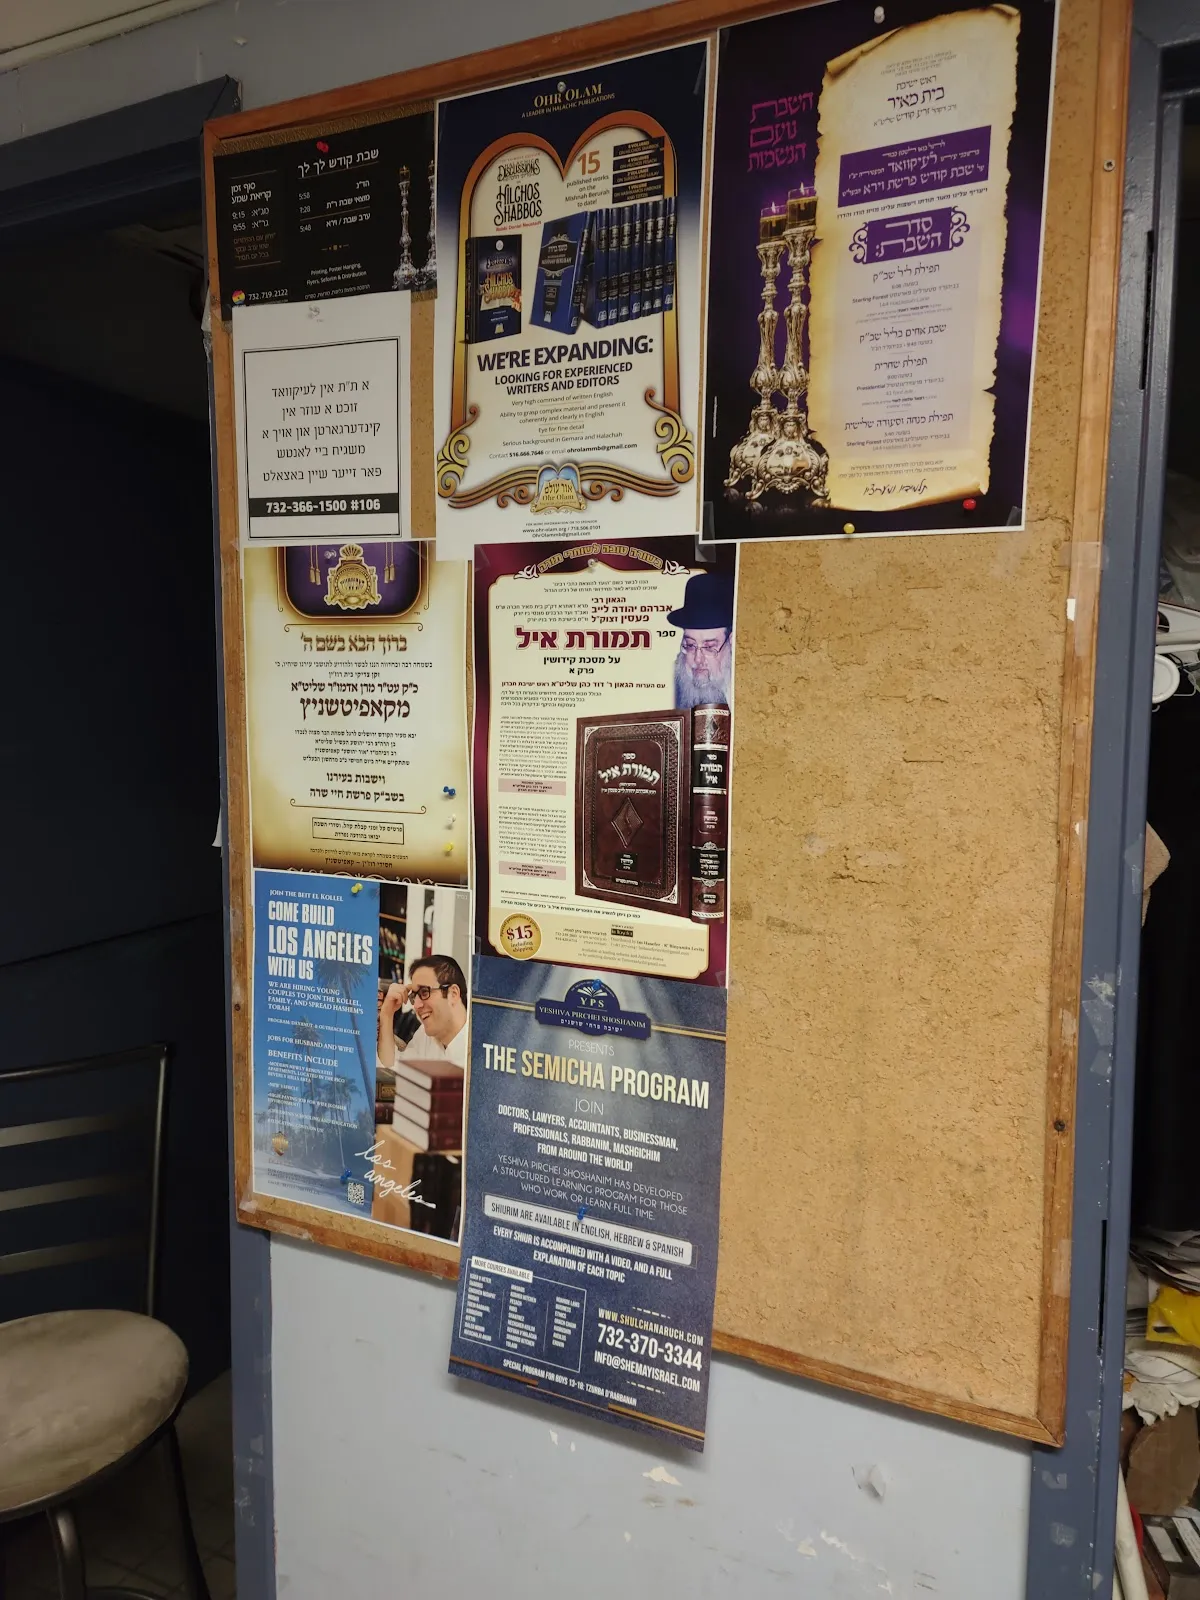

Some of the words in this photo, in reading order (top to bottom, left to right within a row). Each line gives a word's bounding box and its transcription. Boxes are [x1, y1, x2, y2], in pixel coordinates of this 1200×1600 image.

[534, 92, 563, 107] OHR
[566, 83, 601, 101] OLAM
[328, 154, 352, 168] קודש
[356, 148, 378, 162] שבת
[297, 162, 310, 177] לך
[313, 158, 325, 174] לך
[576, 150, 600, 175] 15
[231, 194, 248, 204] שמע
[249, 190, 271, 201] קריאת
[298, 191, 310, 200] 5:58
[495, 182, 541, 205] HILCHOS
[231, 210, 245, 219] 9:15
[493, 199, 542, 226] SHABBOS
[232, 222, 246, 231] 9:55
[885, 216, 932, 232] סדר
[247, 288, 288, 300] 732.719.2122
[476, 348, 530, 371] WE'RE
[534, 336, 653, 365] EXPANDING:
[873, 360, 900, 371] שחרית
[902, 357, 927, 367] תפילת
[494, 371, 540, 385] LOOKING
[542, 369, 562, 380] FOR
[564, 361, 632, 378] EXPERIENCED
[271, 383, 316, 399] לעיקוואד
[319, 383, 333, 397] אין
[338, 381, 357, 392] ת"ת
[361, 380, 369, 390] א
[506, 382, 549, 395] WRITERS
[551, 379, 574, 391] AND
[576, 375, 619, 388] EDITORS
[282, 407, 295, 421] אין
[299, 405, 320, 415] עוזר
[324, 404, 331, 414] א
[335, 402, 357, 413] זוכט
[262, 429, 268, 438] א
[272, 428, 292, 442] אויך
[295, 426, 309, 440] און
[313, 422, 380, 440] קינדערגארטן
[276, 446, 310, 458] לאנטש
[314, 446, 328, 456] ביי
[332, 444, 365, 455] משגיח
[262, 469, 304, 481] באצאלט
[307, 469, 327, 482] שיין
[331, 468, 356, 478] זייער
[360, 467, 381, 477] פאר
[265, 499, 347, 513] 732-366-1500
[350, 498, 380, 510] #106
[591, 604, 609, 613] לייב
[640, 604, 673, 613] אברהם
[516, 627, 557, 649] איל
[565, 631, 649, 648] תמורת
[543, 656, 576, 665] קידושין
[607, 655, 620, 663] על
[577, 667, 594, 675] פרק
[299, 697, 410, 722] מקאפיטשניץ
[326, 772, 352, 782] בעירנו
[354, 773, 385, 784] וישבות
[309, 788, 328, 797] שרה
[330, 789, 343, 798] חיי
[345, 790, 371, 800] פרשת
[373, 791, 404, 802] בשב"ק
[320, 893, 343, 901] KOLLEL
[268, 900, 298, 922] COME
[301, 903, 334, 926] BUILD
[506, 924, 535, 941] $15
[268, 924, 297, 955] LOS
[302, 928, 372, 965] ANGELES
[267, 955, 295, 978] WITH
[298, 959, 313, 980] US
[292, 983, 315, 992] HIRING
[316, 986, 340, 995] YOUNG
[539, 1006, 570, 1016] YESHIVA
[571, 1011, 599, 1021] PIRCHEI
[601, 1015, 645, 1028] SHOSHANIM
[568, 1039, 614, 1056] PRESENTS
[267, 1049, 302, 1061] BENEFITS
[304, 1055, 338, 1067] INCLUDE
[482, 1042, 516, 1073] THE
[521, 1049, 605, 1090] SEMICHA
[610, 1064, 709, 1109] PROGRAM
[574, 1097, 603, 1115] JOIN
[497, 1104, 530, 1121] DOCTORS,
[532, 1110, 566, 1128] LAWYERS,
[568, 1117, 621, 1139] ACCOUNTANTS,
[623, 1128, 678, 1151] BUSINESSMAN,
[512, 1123, 570, 1144] PROFESSIONALS,
[571, 1134, 611, 1152] RABBANIM,
[612, 1142, 660, 1162] MASHGICHIM
[537, 1142, 557, 1156] FROM
[558, 1146, 587, 1162] AROUND
[588, 1152, 603, 1165] THE
[604, 1156, 632, 1172] WORLD!
[491, 1202, 518, 1217] SHIURIM
[519, 1209, 533, 1221] ARE
[534, 1212, 570, 1230] AVAILABLE
[571, 1221, 580, 1232] IN
[580, 1223, 611, 1241] ENGLISH,
[613, 1231, 644, 1248] HEBREW
[645, 1239, 650, 1249] &
[652, 1240, 683, 1257] SPANISH
[493, 1225, 513, 1239] EVERY
[513, 1230, 532, 1244] SHIUR
[532, 1235, 540, 1246] IS
[540, 1237, 585, 1257] ACCOMPANIED
[586, 1248, 603, 1262] WITH
[604, 1253, 609, 1264] A
[611, 1254, 632, 1270] VIDEO,
[633, 1260, 648, 1273] AND
[648, 1264, 654, 1275] A
[655, 1266, 672, 1280] FULL
[533, 1250, 576, 1270] EXPLANATION
[576, 1261, 586, 1272] OF
[586, 1263, 604, 1277] EACH
[605, 1268, 625, 1283] TOPIC
[598, 1307, 703, 1346] WWW.SHULCHANARUCH.COM
[597, 1323, 702, 1371] 732-370-3344
[594, 1350, 700, 1392] INFO@SHEMAYISRAEL.COM
